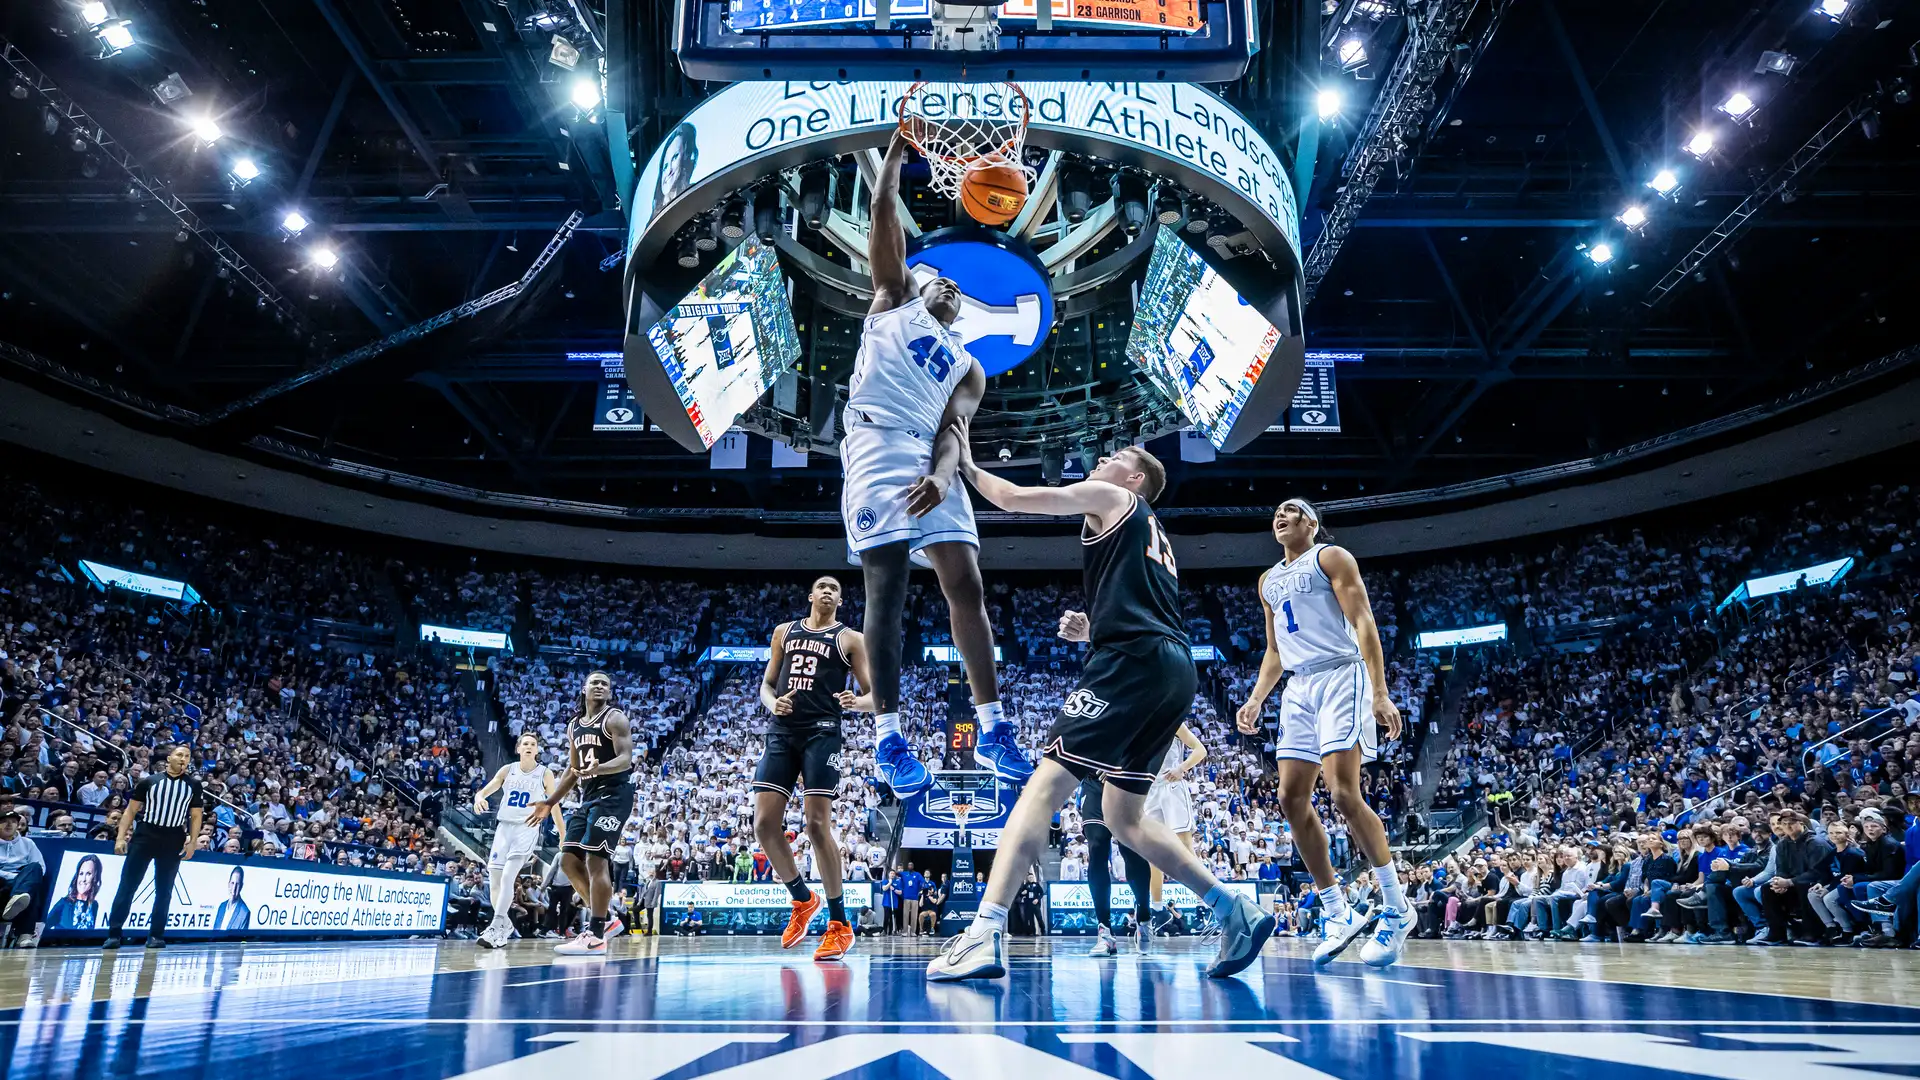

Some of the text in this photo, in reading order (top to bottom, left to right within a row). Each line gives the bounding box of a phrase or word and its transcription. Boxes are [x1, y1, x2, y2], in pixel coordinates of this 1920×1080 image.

[760, 12, 774, 25] 12
[790, 9, 799, 21] 4
[820, 7, 826, 19] 1
[844, 5, 853, 17] 0
[1077, 5, 1194, 27] 23 GARRISON 6 3
[746, 108, 830, 150] One
[850, 88, 1066, 126] Licensed
[1087, 100, 1227, 177] Athlete
[1238, 166, 1262, 204] at
[1269, 193, 1279, 221] a
[677, 304, 719, 317] BRIGHAM
[658, 345, 670, 359] 62
[907, 335, 956, 382] 45
[723, 437, 735, 450] 11
[1266, 572, 1313, 607] BYU
[1282, 600, 1299, 634] 1
[785, 639, 831, 659] OKLAHOMA
[790, 654, 818, 676] 23
[788, 677, 814, 691] STATE
[955, 723, 973, 733] 9:09
[573, 733, 603, 750] KLAHOMA
[953, 732, 972, 748] 21
[579, 748, 596, 768] 14
[507, 790, 531, 808] 20
[274, 877, 433, 907] Leading the NIL Landscape,
[734, 887, 770, 897] Leading
[772, 887, 788, 896] the
[1174, 887, 1190, 896] NIL
[725, 896, 867, 905] One Licensed Time
[1111, 896, 1131, 906] One
[166, 913, 212, 927] ESTATE
[257, 904, 438, 928] One Licensed Athlete at a Time
